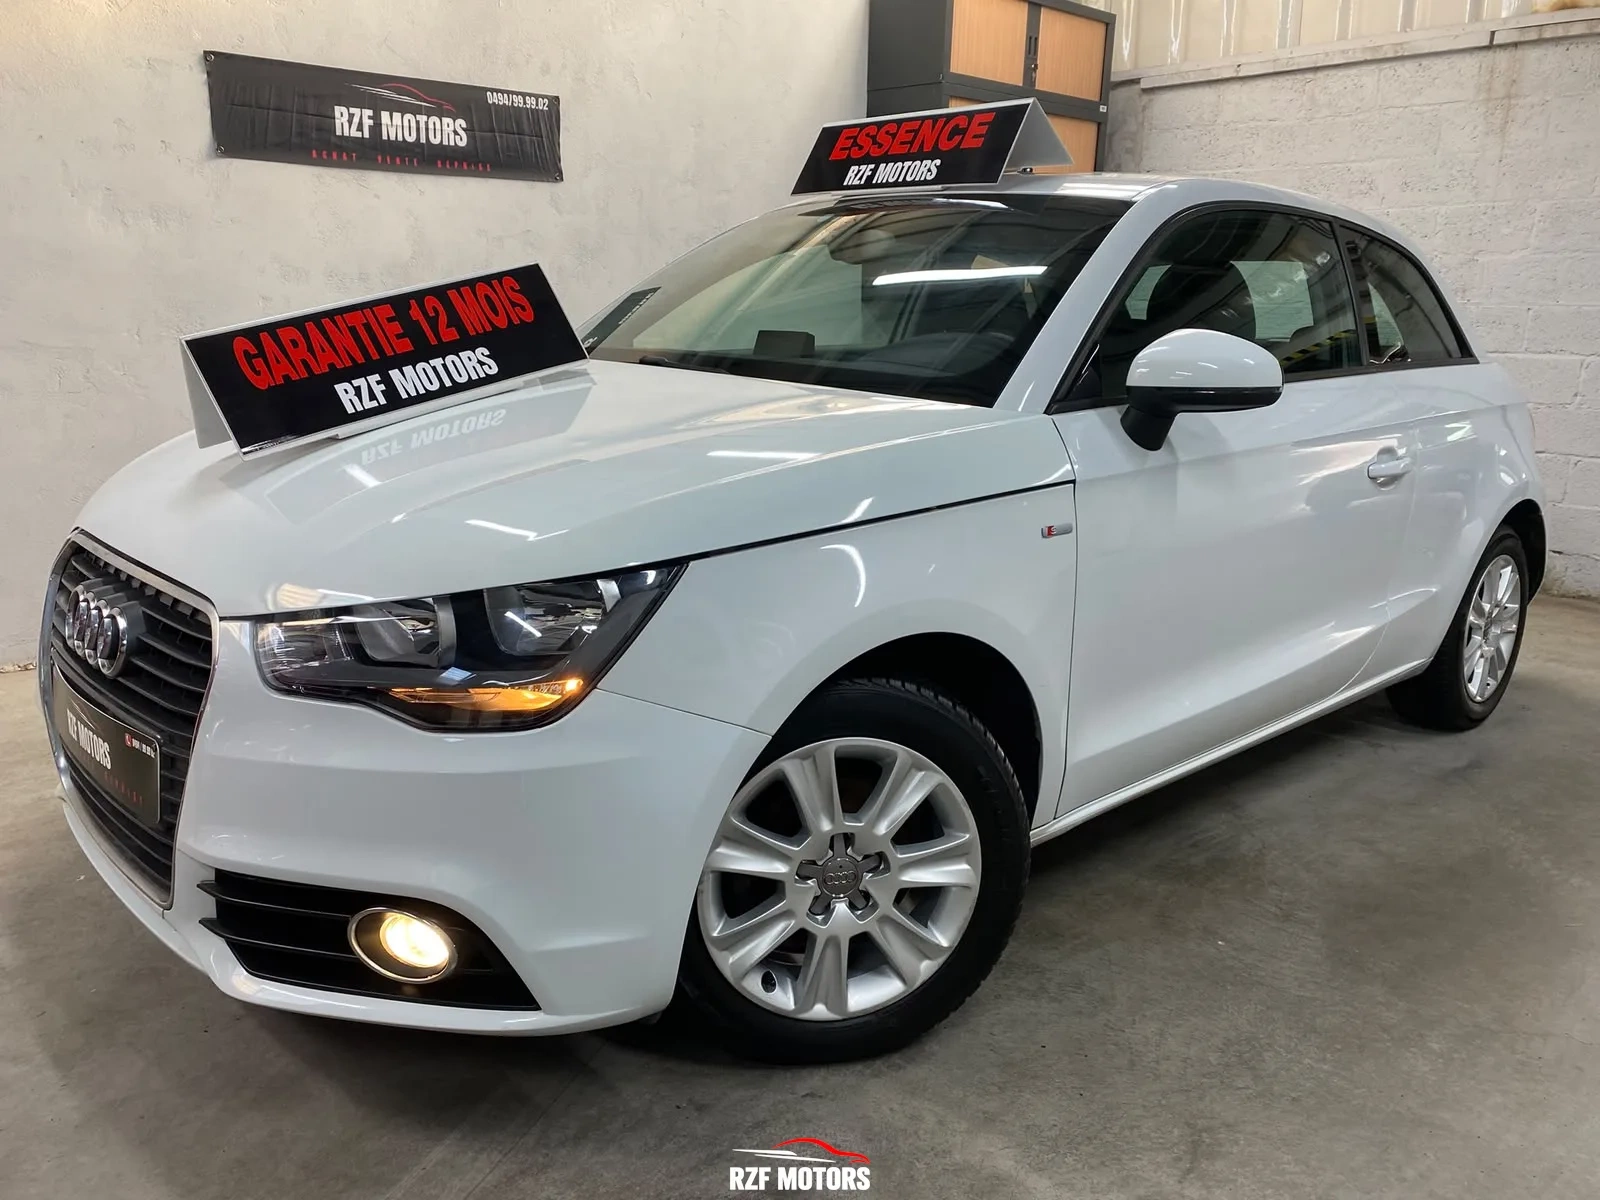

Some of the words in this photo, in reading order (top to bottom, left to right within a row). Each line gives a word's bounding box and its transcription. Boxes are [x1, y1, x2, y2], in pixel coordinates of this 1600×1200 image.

[486, 91, 549, 110] 0494/99.99.02
[334, 105, 375, 139] RZF
[381, 114, 468, 147] MOTORS
[828, 111, 996, 161] ESSENCE
[843, 162, 877, 186] RZF
[872, 158, 941, 183] MOTORS
[232, 303, 415, 390] GARANTIE
[408, 296, 460, 346] 12
[447, 275, 535, 336] MOIS
[334, 372, 387, 415] RZF
[390, 347, 499, 400] MOTORS
[77, 720, 112, 770] MOTORS
